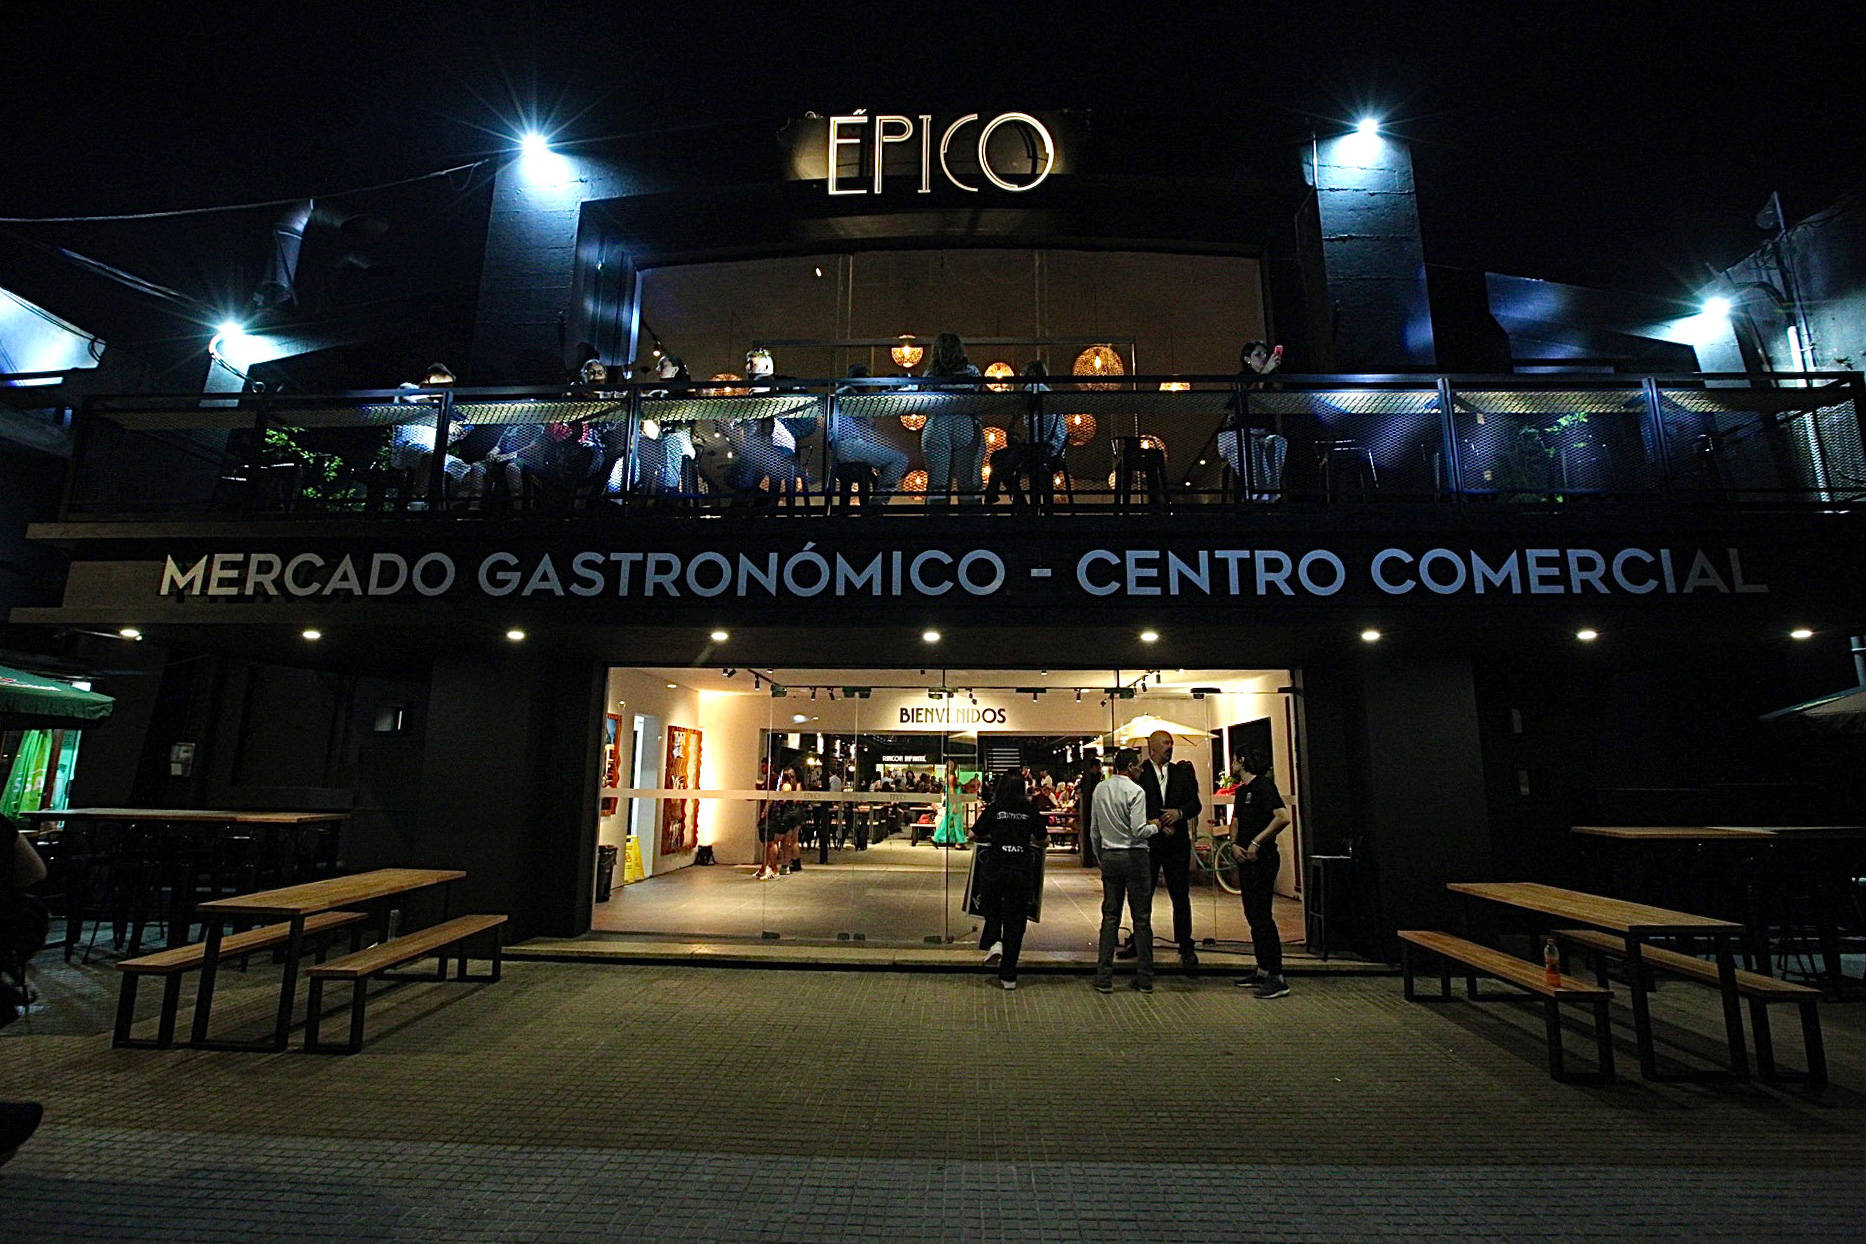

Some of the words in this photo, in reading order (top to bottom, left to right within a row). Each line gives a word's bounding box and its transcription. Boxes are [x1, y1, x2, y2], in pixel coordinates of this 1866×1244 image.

[828, 108, 1055, 195] ÉPICO
[159, 551, 456, 597] MERCADO
[477, 541, 1006, 597] GASTRONÓMICO
[1076, 549, 1346, 596] CENTRO
[1370, 547, 1770, 595] COMERCIAL
[899, 707, 1007, 724] BIENVENIDOS
